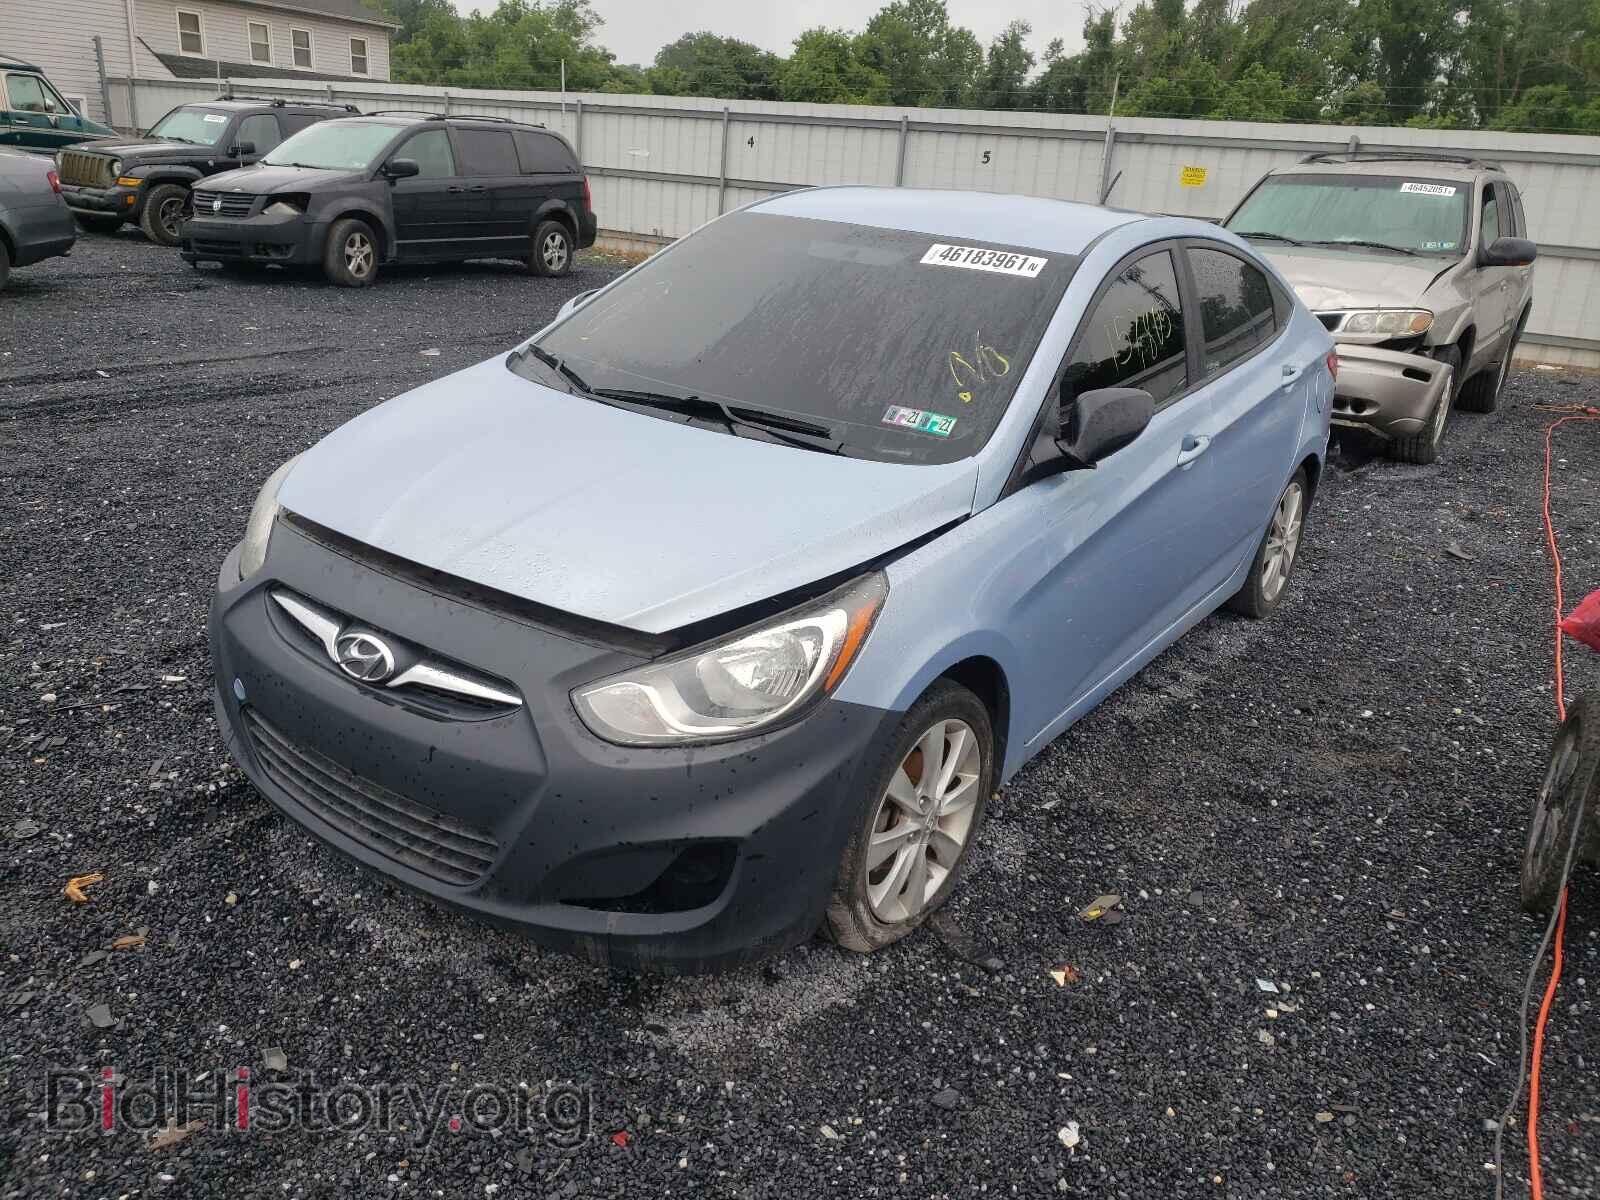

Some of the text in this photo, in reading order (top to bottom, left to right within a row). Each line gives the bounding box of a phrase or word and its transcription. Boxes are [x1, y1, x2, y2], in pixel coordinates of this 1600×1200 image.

[747, 135, 755, 149] 4
[981, 150, 991, 165] 5
[938, 246, 1030, 271] 46183961
